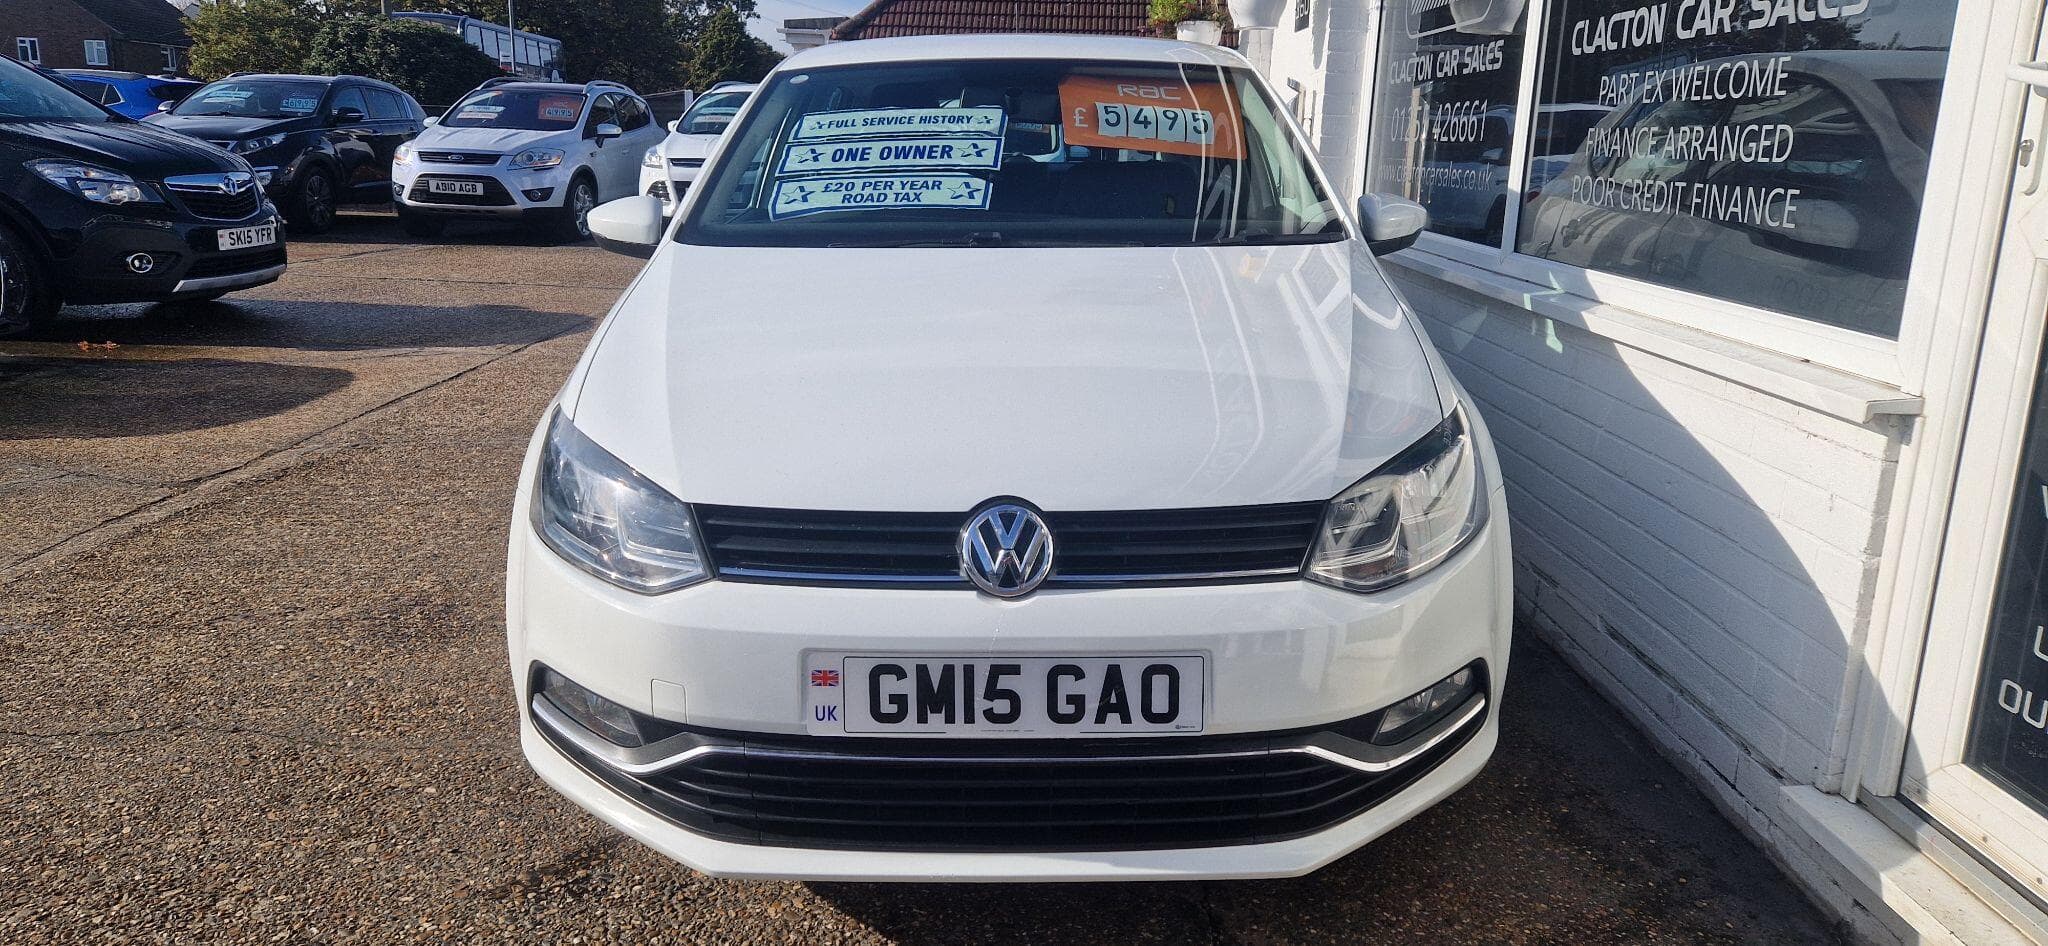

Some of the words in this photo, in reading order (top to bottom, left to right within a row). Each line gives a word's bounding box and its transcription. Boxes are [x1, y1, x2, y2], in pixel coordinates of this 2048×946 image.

[1571, 3, 1667, 56] CLACTON
[1676, 0, 1739, 40] CAR
[1390, 54, 1434, 84] CLACTON
[1436, 49, 1460, 78] CAR
[1463, 39, 1505, 74] SALES
[1599, 71, 1641, 106] PART
[1642, 69, 1666, 103] EX
[1667, 56, 1791, 101] WELCOME
[828, 119, 857, 129] FULL
[862, 115, 915, 127] SERVICE
[919, 114, 974, 124] HISTORY
[1073, 106, 1089, 128] £
[1103, 105, 1209, 135] 5495
[1391, 103, 1431, 142] 0125
[1432, 99, 1488, 142] 426661
[831, 146, 873, 163] ONE
[879, 144, 954, 161] OWNER
[1585, 126, 1659, 159] FINANCE
[1661, 124, 1794, 163] ARRANGED
[822, 181, 856, 193] £20
[861, 181, 895, 191] PER
[900, 180, 943, 191] YEAR
[842, 193, 888, 204] ROAD
[893, 192, 923, 203] TAX
[1572, 175, 1615, 208] POOR
[1620, 179, 1687, 216] CREDIT
[1691, 182, 1800, 229] FINANCE
[228, 230, 253, 246] SK15
[255, 227, 272, 243] YFR
[814, 704, 837, 722] UK
[868, 663, 1022, 724] GM15
[1046, 663, 1181, 725] GAO
[1999, 678, 2048, 729] OU
